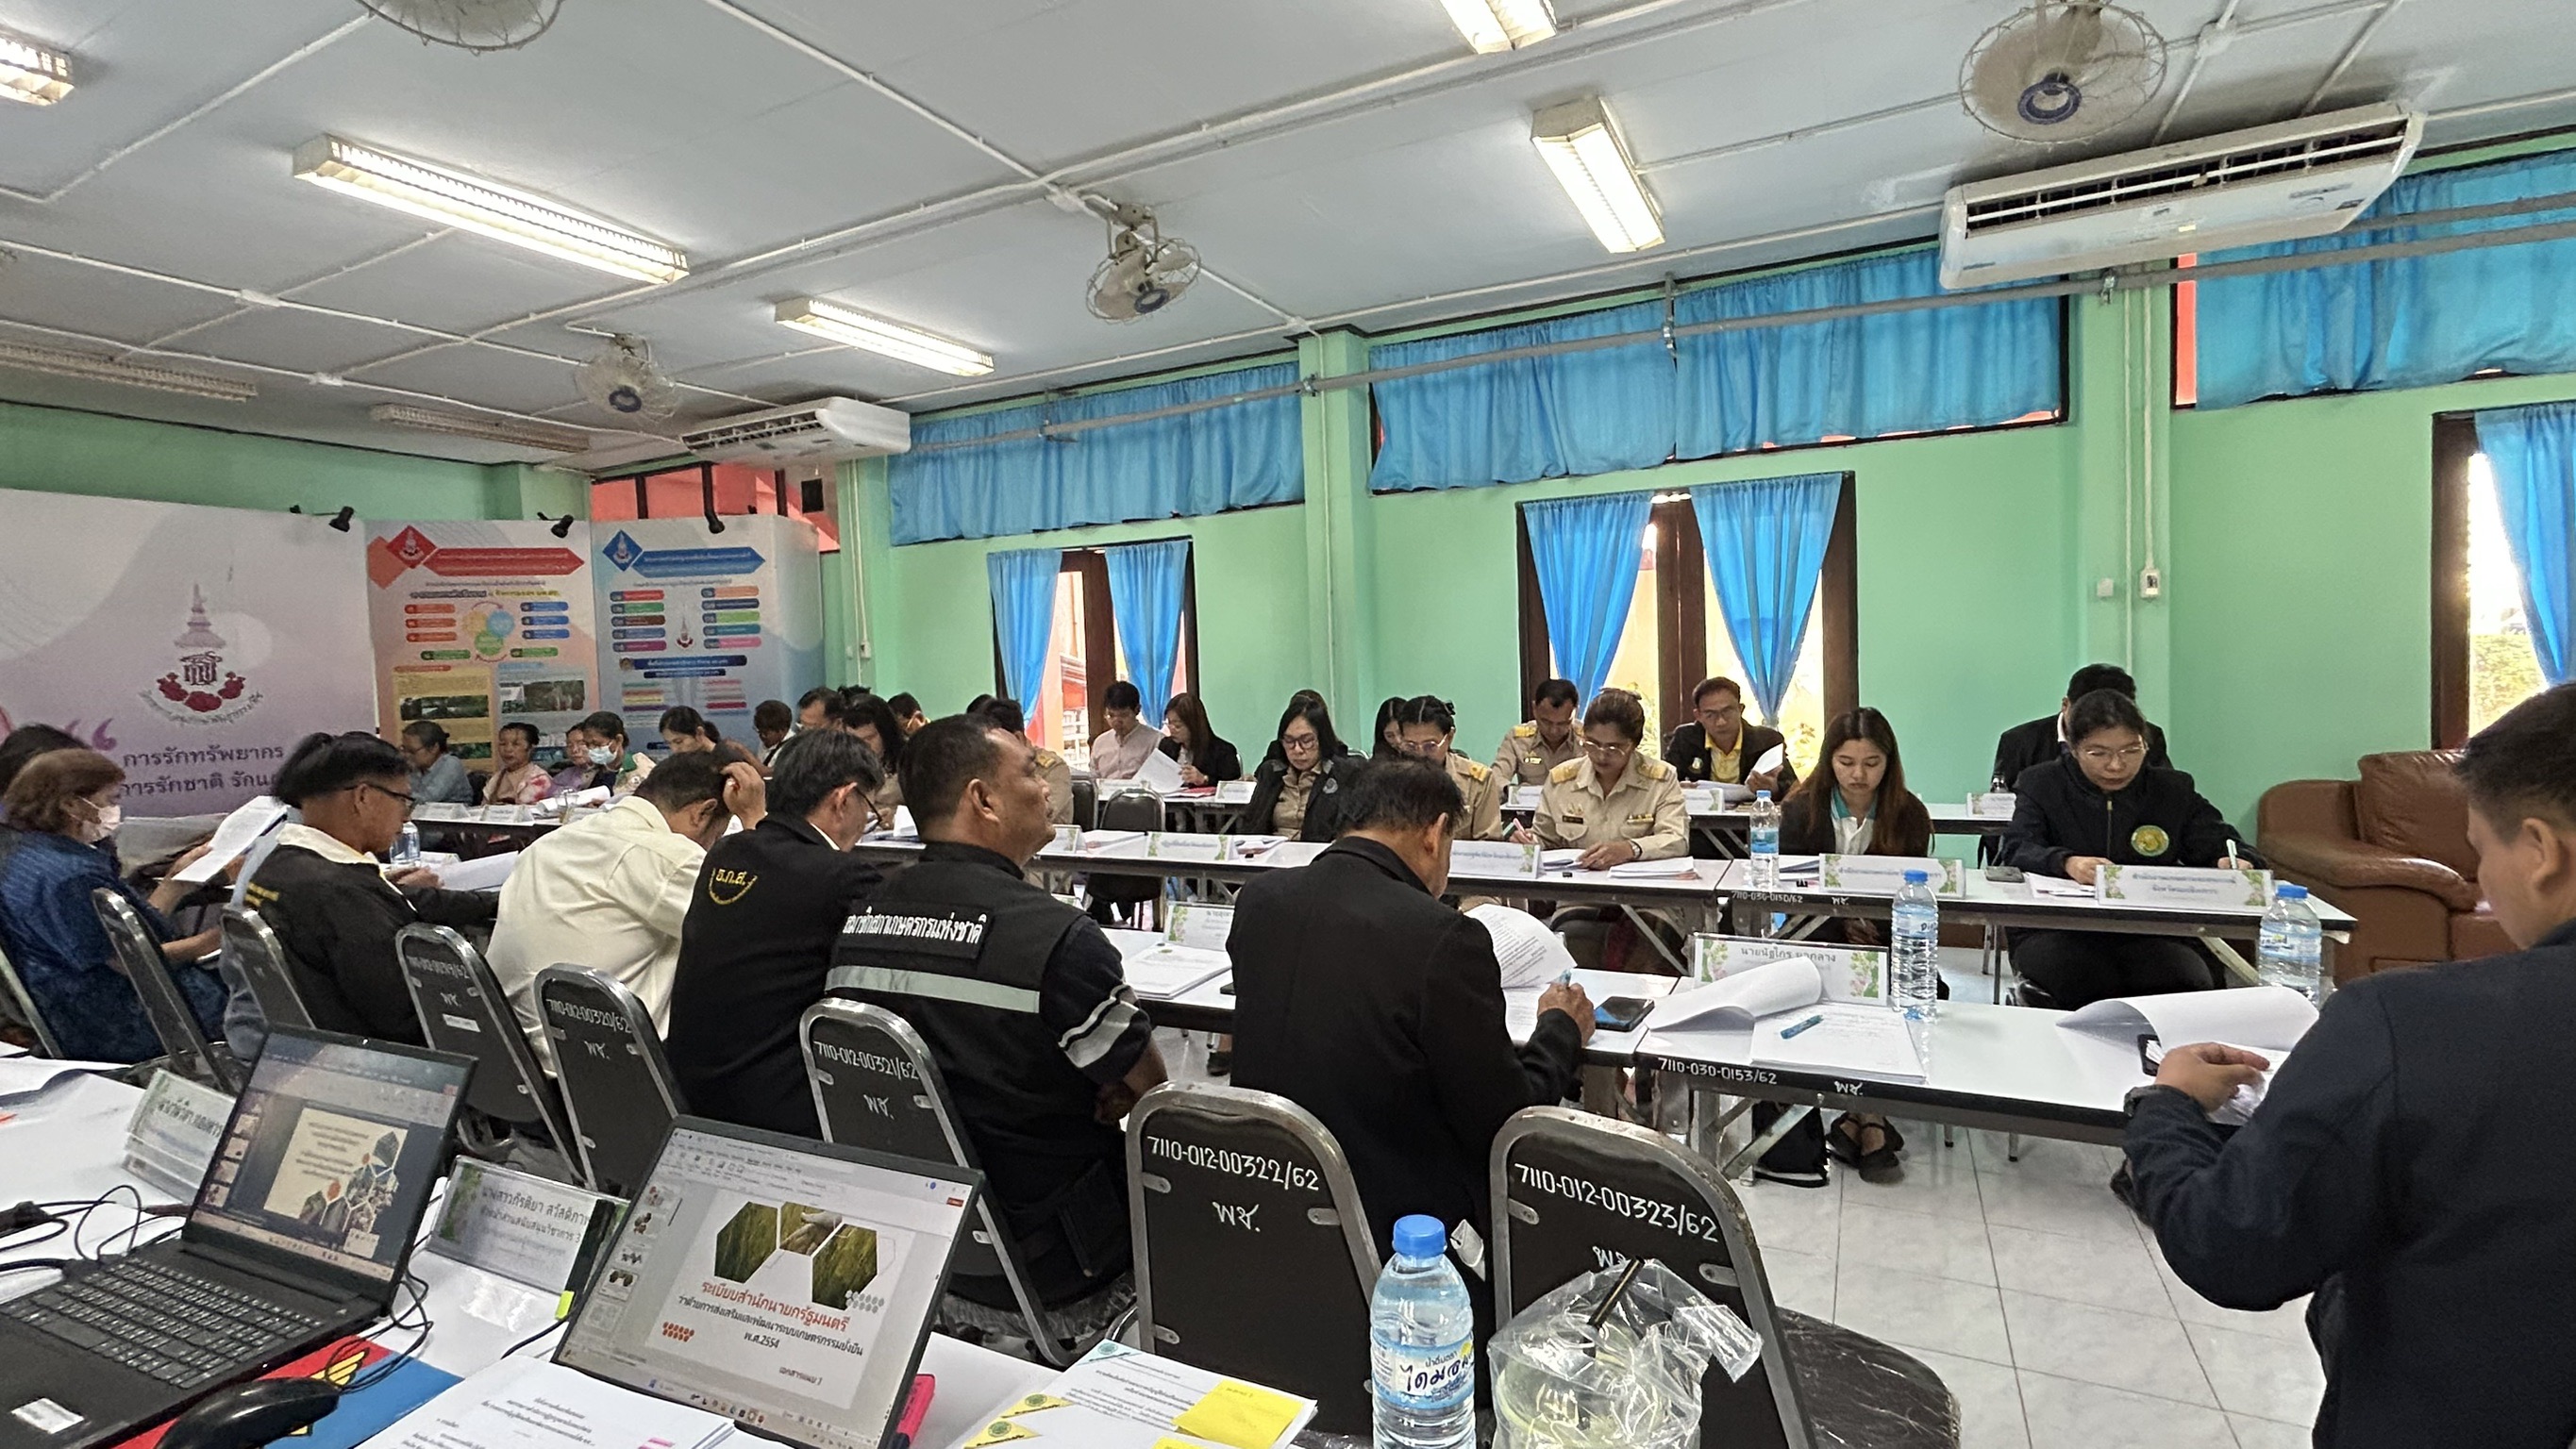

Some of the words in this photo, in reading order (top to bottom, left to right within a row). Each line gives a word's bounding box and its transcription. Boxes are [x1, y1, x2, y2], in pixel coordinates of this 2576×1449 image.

[123, 744, 284, 767] การรักทรัพยากร
[715, 868, 747, 886] ธ.ก.ส.
[545, 998, 632, 1034] 7110-012-00320/62
[812, 1041, 920, 1081] 7110-012-00321/62
[1657, 1057, 1778, 1086] 7110-030-0153/62
[1146, 1135, 1320, 1191] 7110-012-00322/62
[1514, 1162, 1719, 1243] 7110-012-00323/62
[701, 1280, 851, 1333] ระเบียบสำนักนายกรัฐมนตรี
[744, 1331, 780, 1350] พ.ศ.2554
